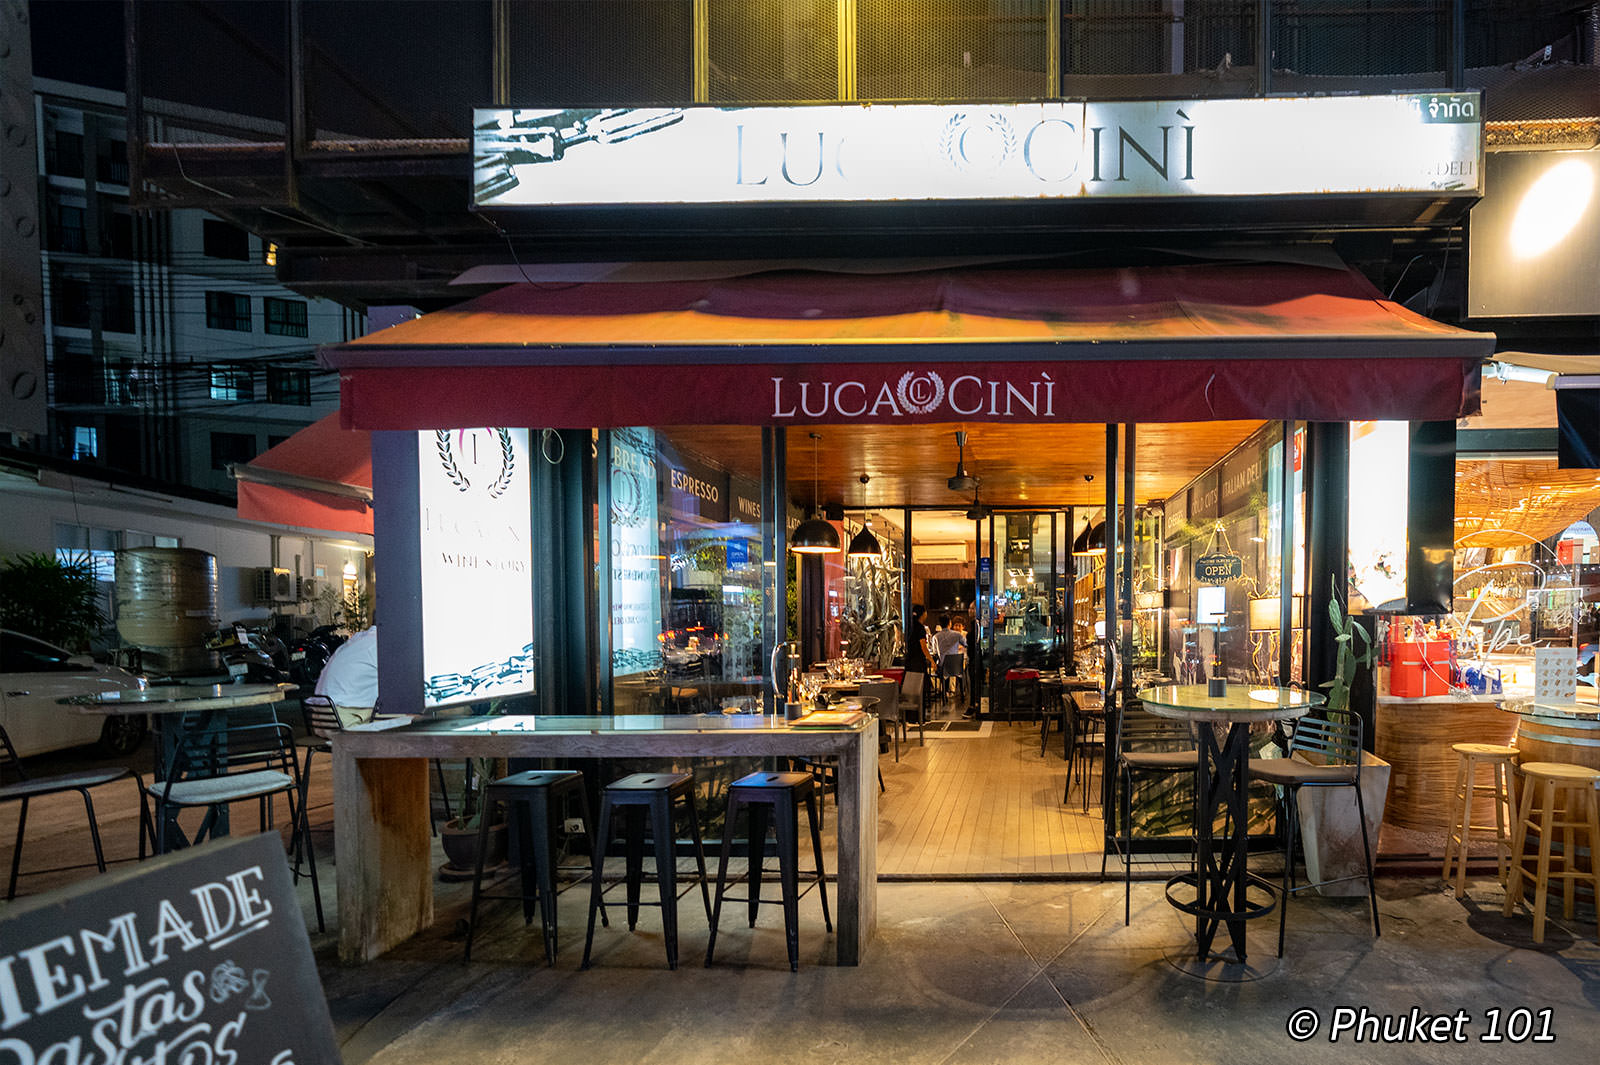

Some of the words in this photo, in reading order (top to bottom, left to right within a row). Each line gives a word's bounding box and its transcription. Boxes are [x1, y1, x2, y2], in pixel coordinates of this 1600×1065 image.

[613, 445, 656, 480] BREAD
[671, 468, 719, 503] ESPRESSO
[738, 496, 761, 518] WINES
[1205, 563, 1233, 576] OPEN
